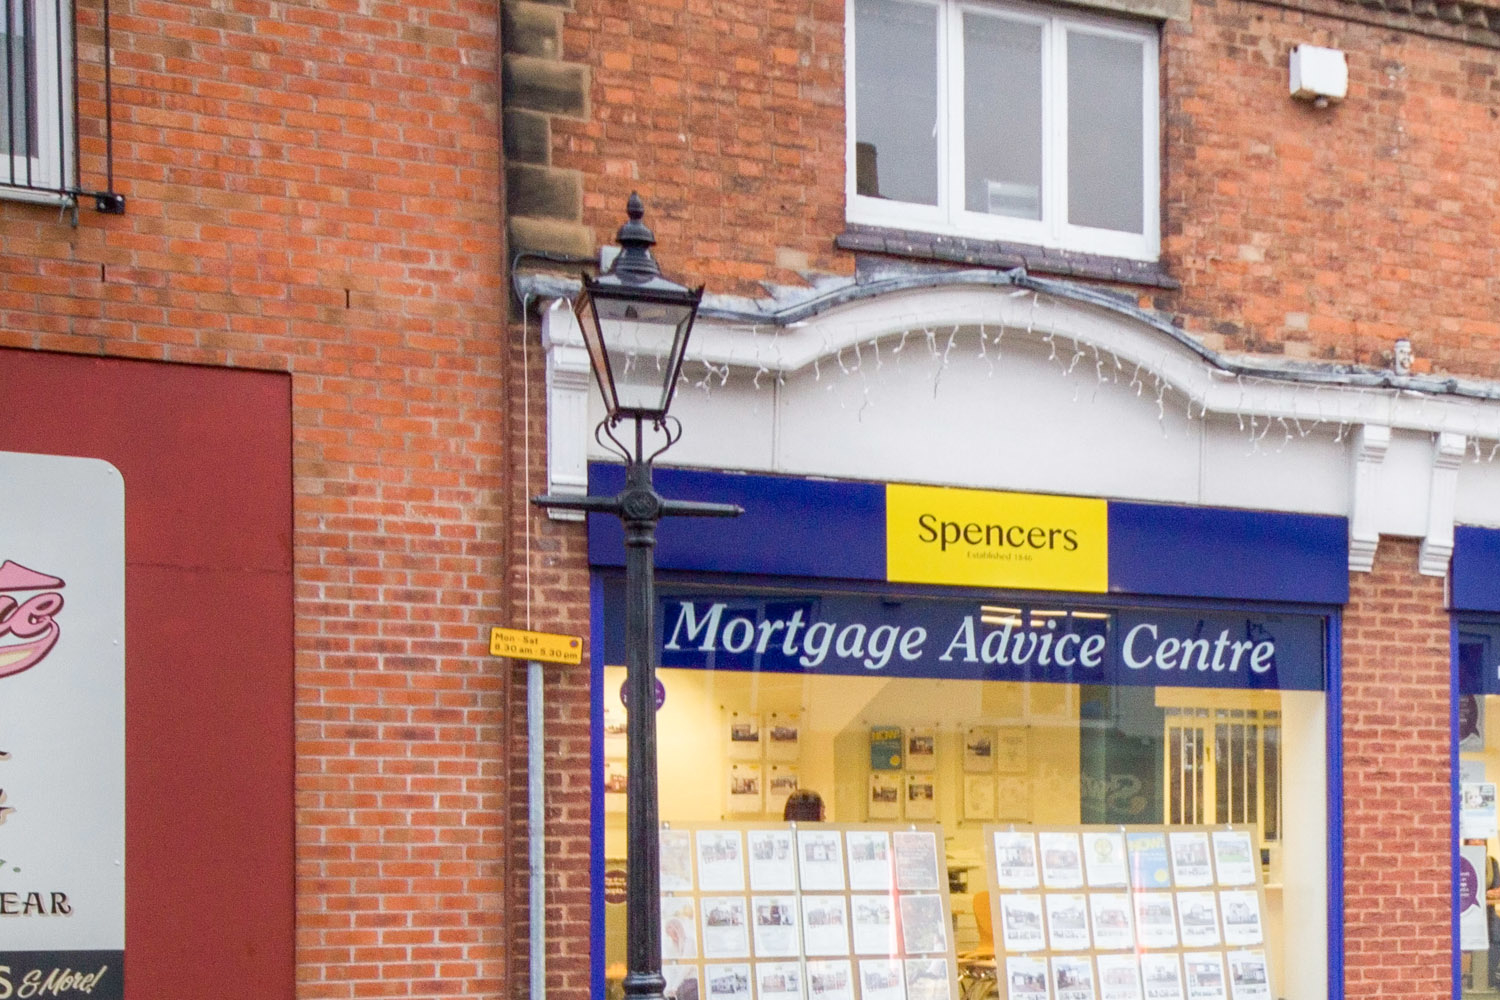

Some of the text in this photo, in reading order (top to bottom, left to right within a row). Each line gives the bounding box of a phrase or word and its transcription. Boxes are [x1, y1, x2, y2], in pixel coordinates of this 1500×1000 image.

[918, 513, 1078, 551] Spencers
[967, 551, 1011, 561] Established
[495, 633, 538, 645] Mon Sat
[664, 601, 1275, 673] Mortgage Advice Centre
[17, 969, 42, 999] &
[38, 965, 108, 997] More!
